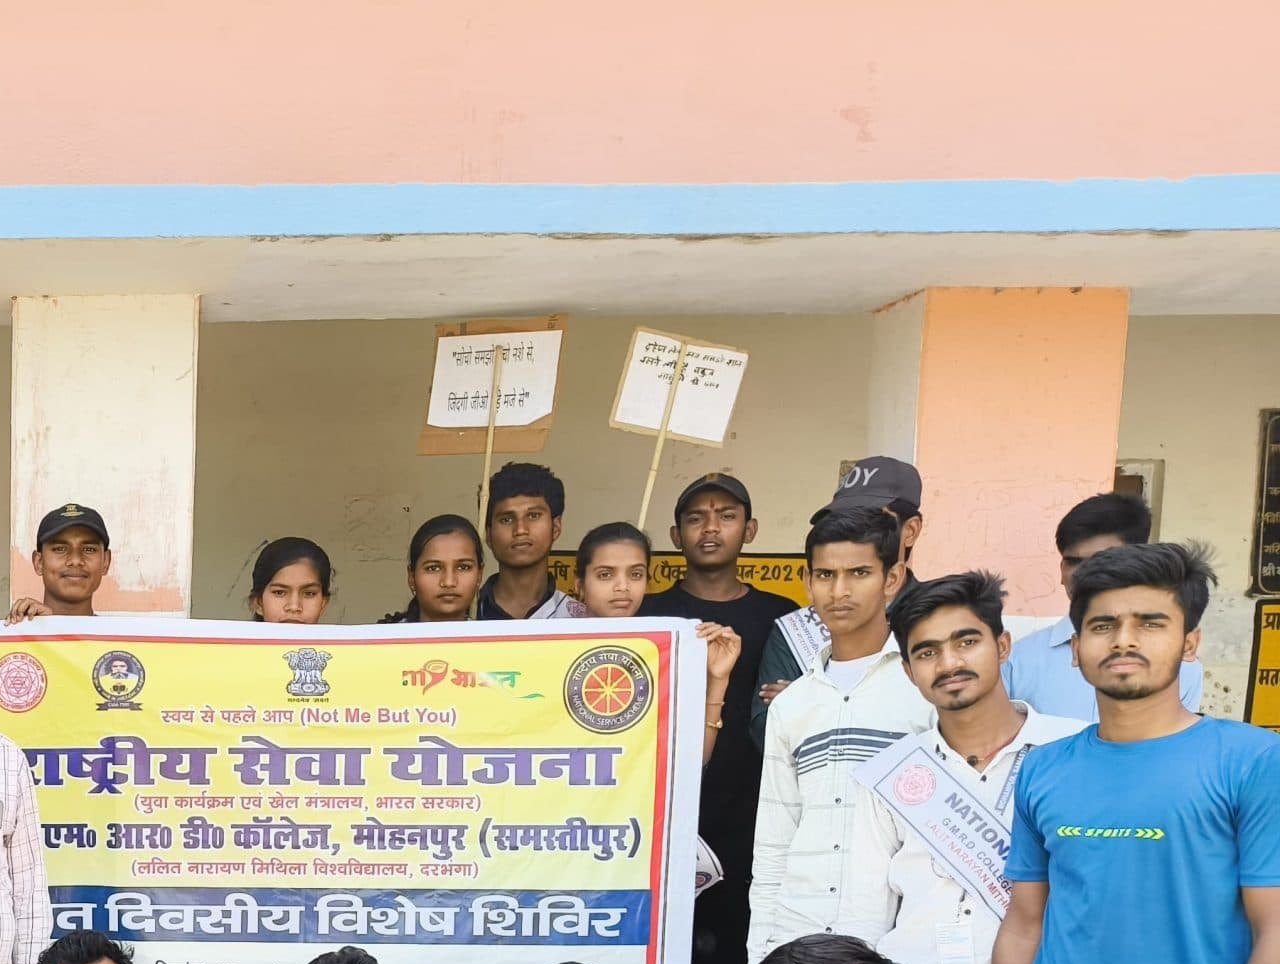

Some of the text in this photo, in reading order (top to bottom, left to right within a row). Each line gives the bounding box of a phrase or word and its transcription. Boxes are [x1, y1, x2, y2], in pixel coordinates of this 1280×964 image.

[200, 705, 215, 724] से
[221, 705, 256, 725] पहले
[262, 709, 294, 724] आप
[300, 707, 339, 727] (Not
[345, 708, 371, 724] Me
[377, 708, 410, 724] But
[415, 708, 457, 727] You)
[573, 694, 595, 724] NATIONAL
[596, 716, 625, 727] SERVICE
[21, 735, 623, 794] राष्ट्रीय सेवा योजना
[134, 791, 481, 813] (युवा कार्यक्रम एवं खेल मंत्रालय, भारत सरकार)
[231, 815, 341, 856] कॉलेज,
[350, 817, 468, 861] मोहनपुर
[479, 817, 641, 861] (समस्तीपुर)
[944, 791, 1010, 861] NATION
[131, 858, 479, 879] (ललित नारायण मिथिला विश्वविद्यालय, दरभंगा)
[948, 841, 989, 882] NARAYAN
[105, 892, 305, 935] दिवसीय
[315, 893, 460, 937] विशेष
[468, 894, 627, 937] शिविर
